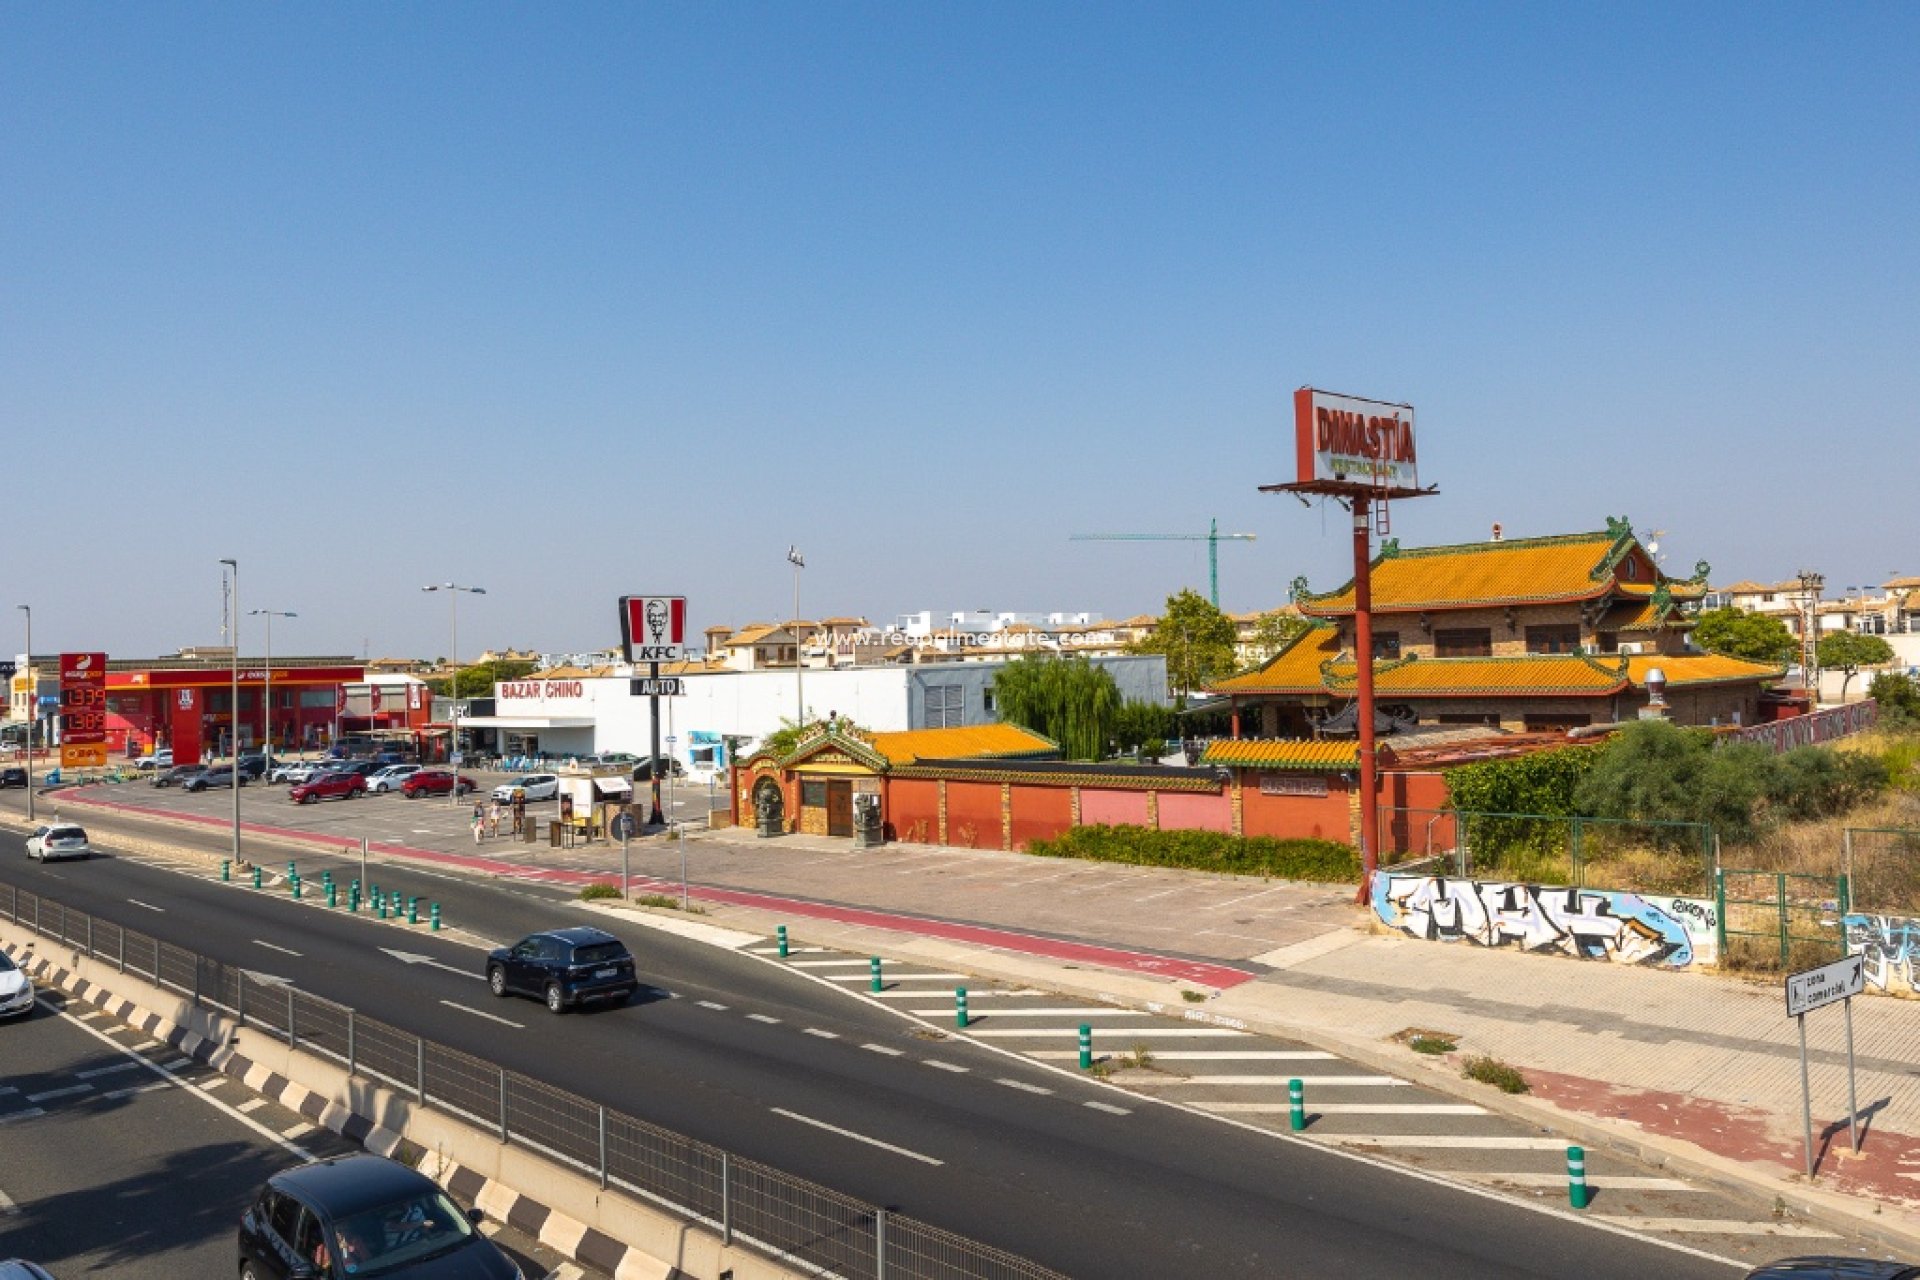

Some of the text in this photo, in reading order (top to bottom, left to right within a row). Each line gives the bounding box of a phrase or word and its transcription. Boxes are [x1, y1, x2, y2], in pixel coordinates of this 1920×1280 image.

[641, 646, 676, 659] KFC
[502, 681, 583, 699] BAZAR CHINO
[1807, 973, 1825, 987] zona
